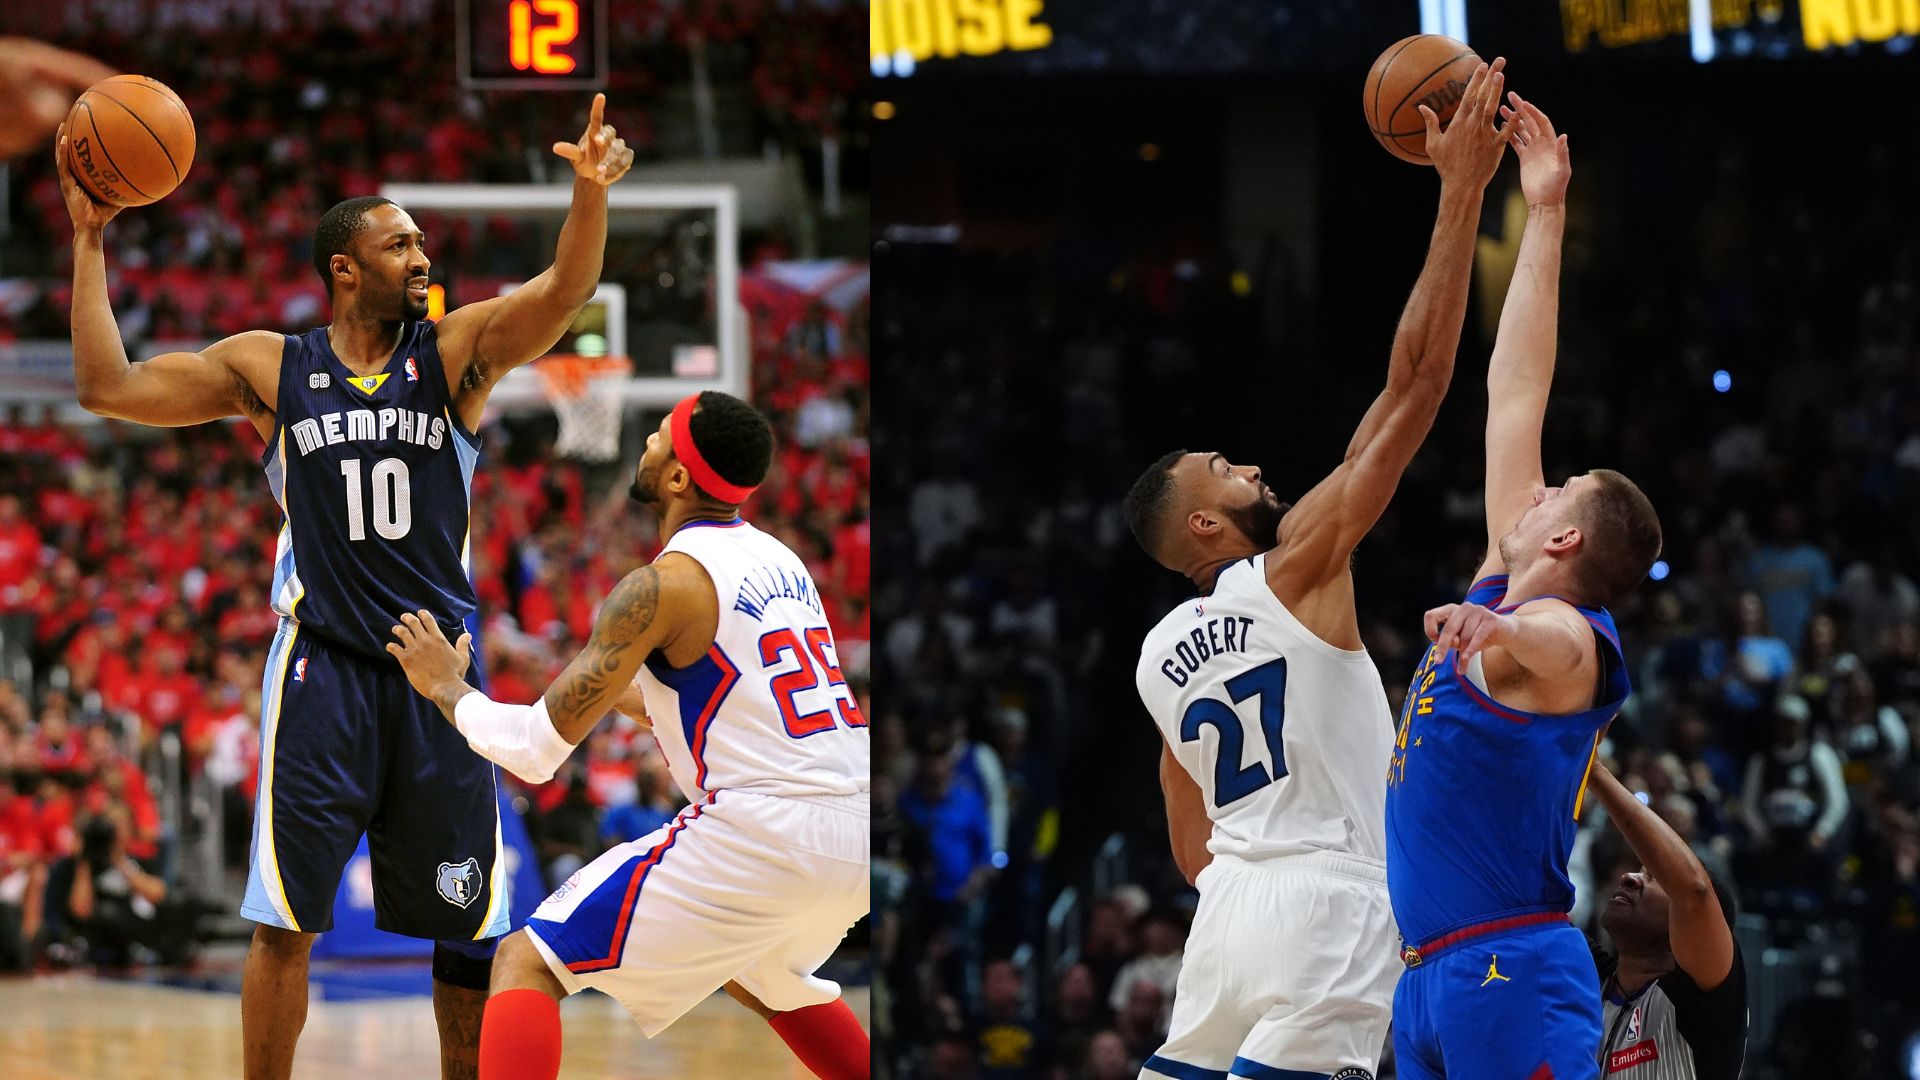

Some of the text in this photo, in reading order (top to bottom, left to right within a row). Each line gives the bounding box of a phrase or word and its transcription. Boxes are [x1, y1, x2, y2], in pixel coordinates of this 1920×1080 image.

[509, 0, 579, 74] 12
[309, 373, 330, 389] GB
[291, 407, 445, 457] MEMPHIS
[340, 457, 412, 541] 10
[733, 566, 820, 623] WILLIAMS
[758, 627, 868, 739] 25
[1161, 616, 1254, 688] GOBERT
[1180, 656, 1290, 809] 27
[1611, 1046, 1652, 1068] Emirates
